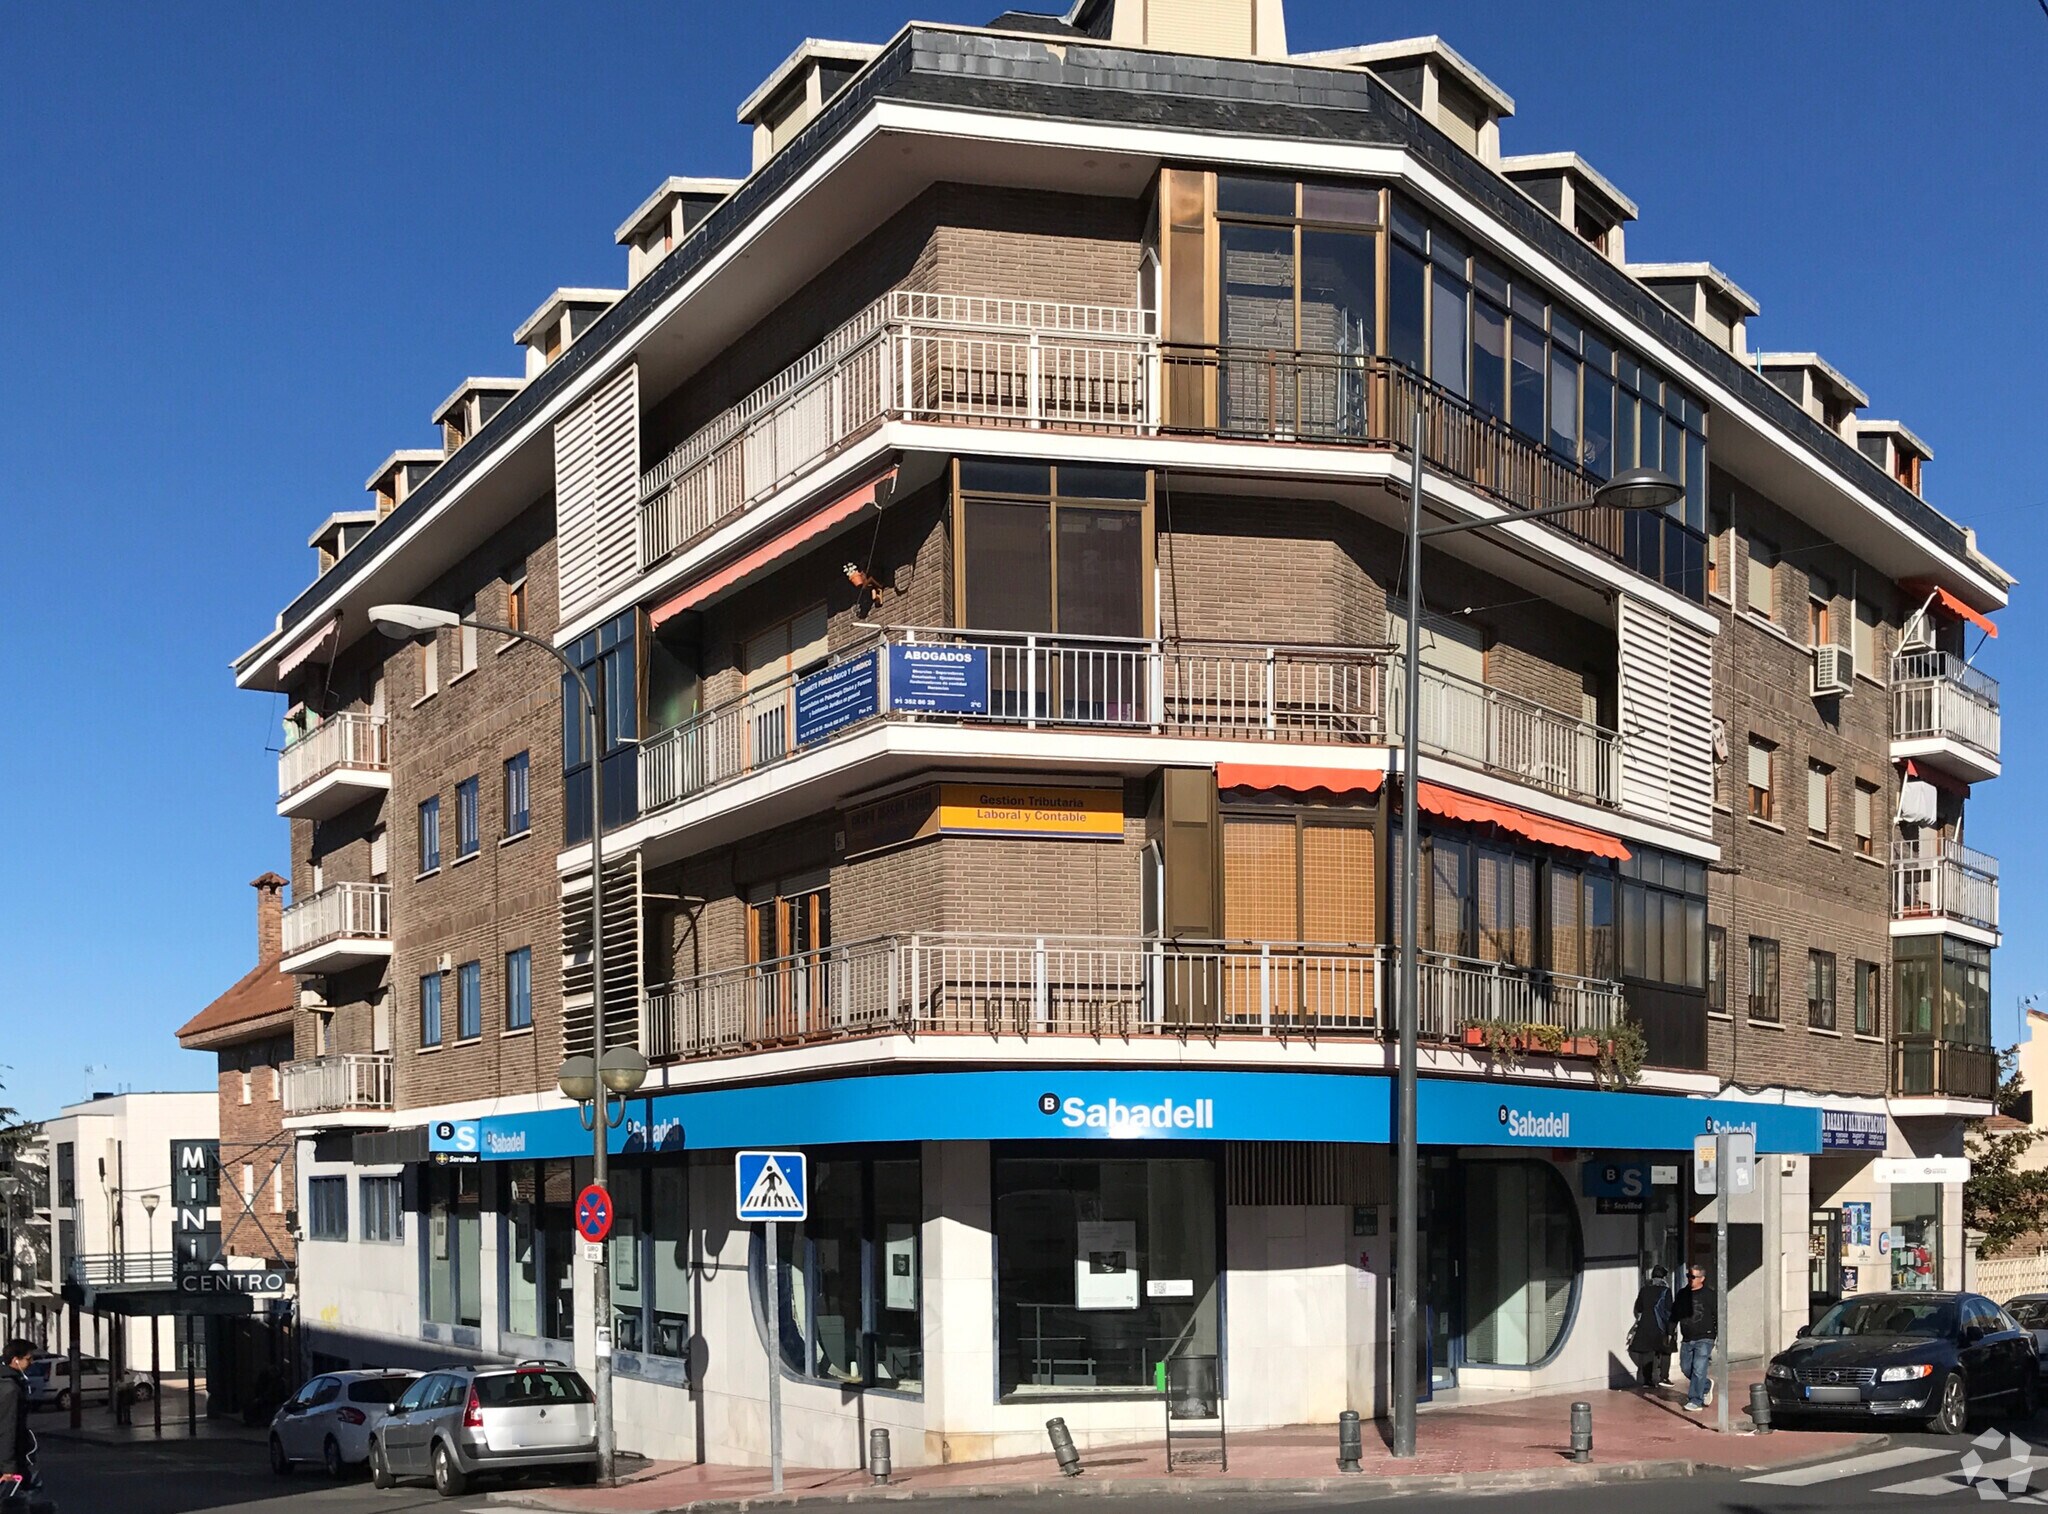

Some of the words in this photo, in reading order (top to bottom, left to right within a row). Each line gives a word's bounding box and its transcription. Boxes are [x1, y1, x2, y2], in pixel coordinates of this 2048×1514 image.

[903, 650, 973, 663] ABOGADOS
[1027, 795, 1085, 808] Tributaria
[977, 808, 1021, 820] Laboral
[1024, 812, 1032, 822] y
[1034, 810, 1087, 822] Contable
[1061, 1096, 1213, 1129] Sabadell
[1508, 1109, 1570, 1138] Sabadell
[456, 1126, 476, 1151] S
[491, 1131, 526, 1154] Sabadell
[1621, 1168, 1643, 1197] S
[182, 1274, 283, 1292] CENTRO
